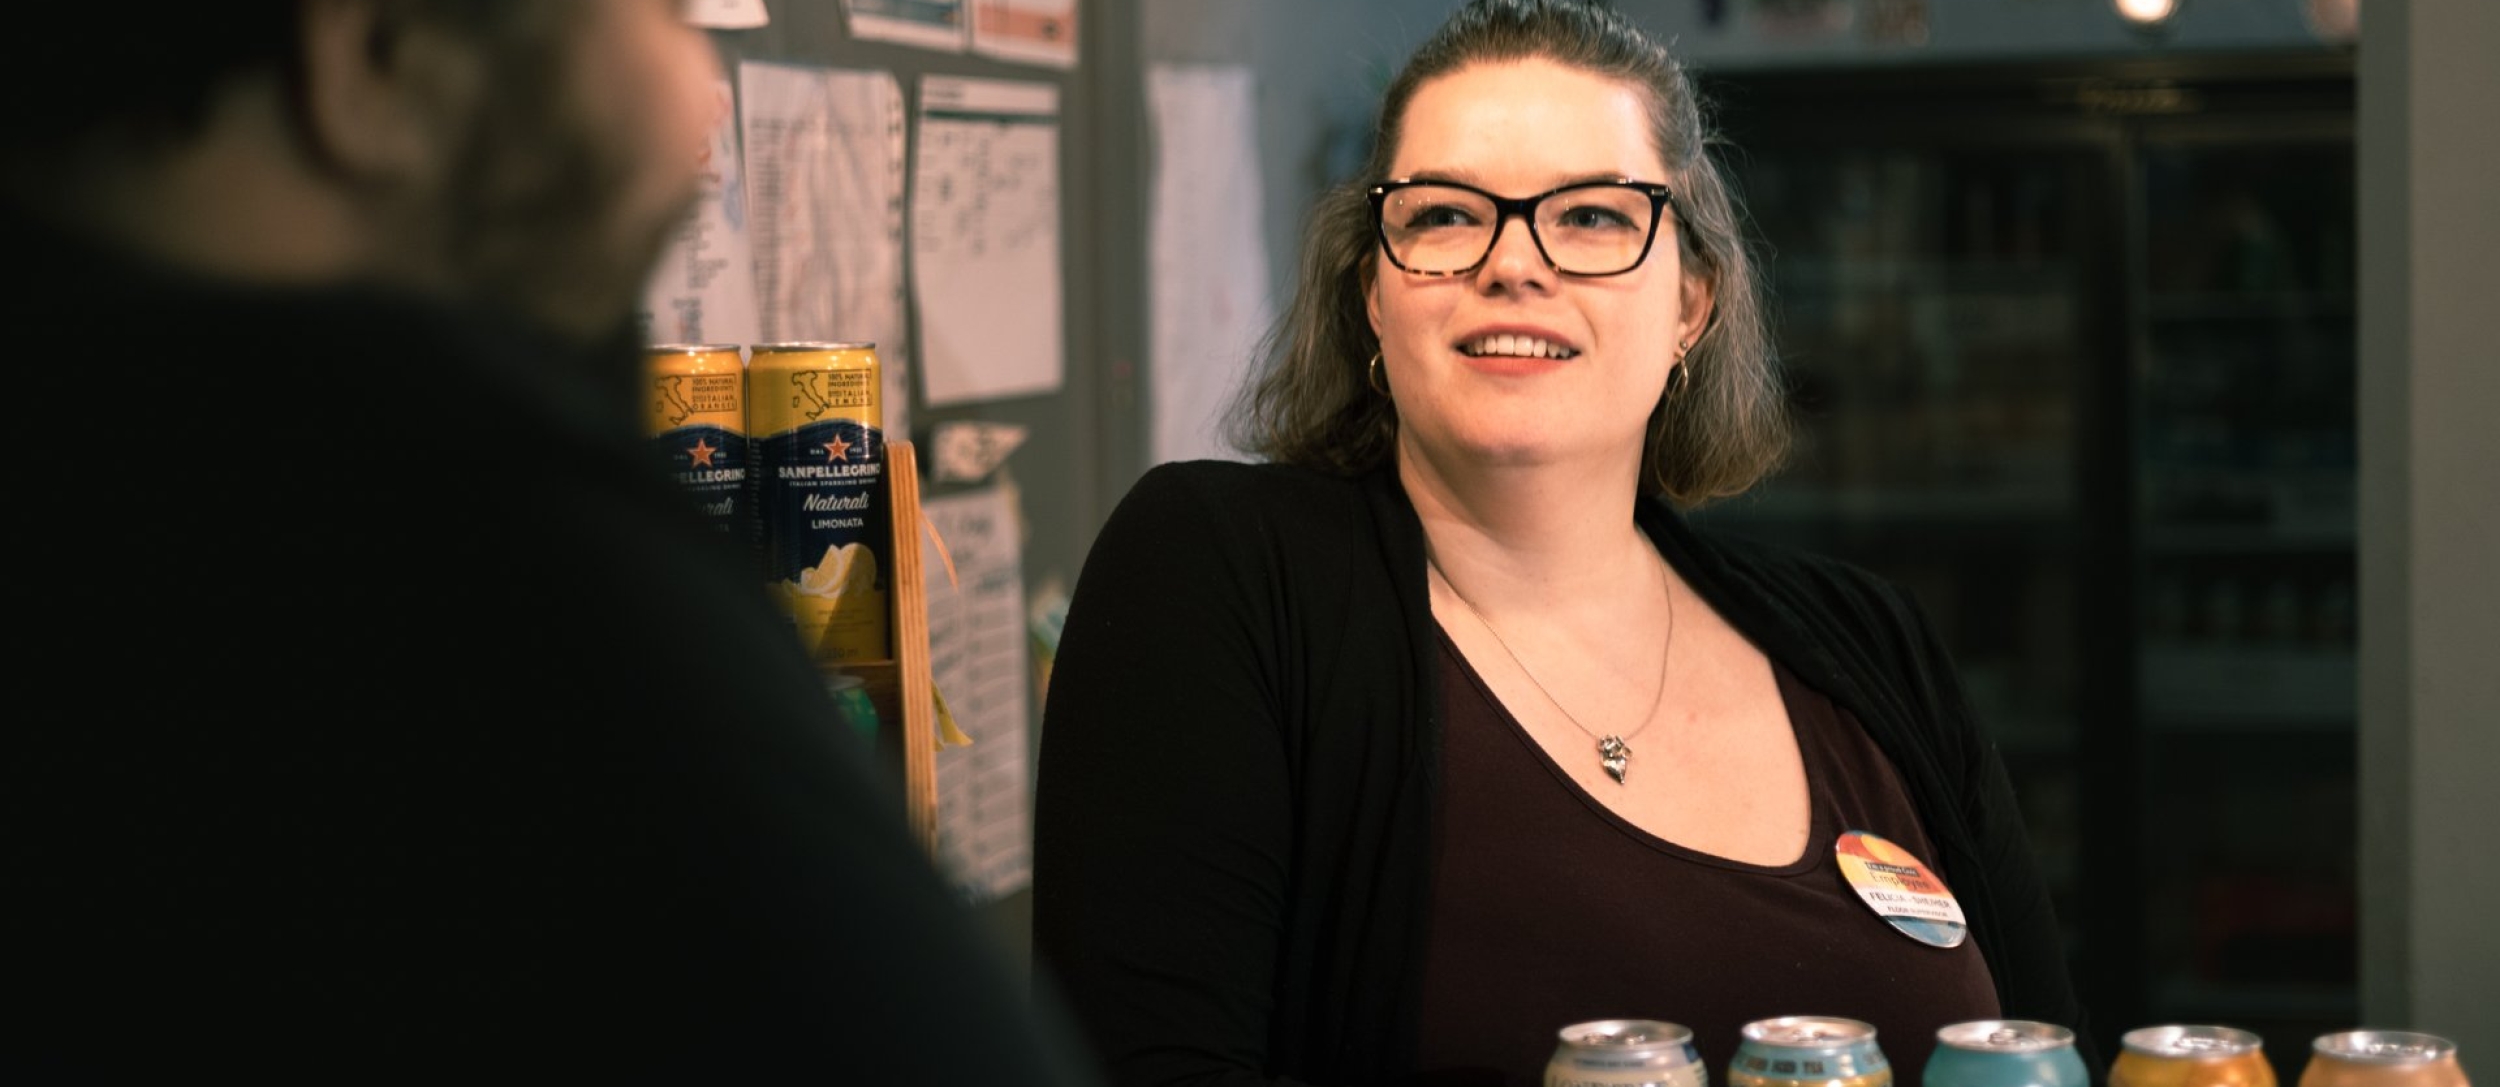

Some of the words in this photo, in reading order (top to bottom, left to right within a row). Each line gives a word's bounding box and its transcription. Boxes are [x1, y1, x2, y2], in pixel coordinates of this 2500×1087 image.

[777, 463, 881, 480] SANPELLEGRINO
[803, 490, 870, 512] Naturali
[811, 517, 864, 530] LIMONATA
